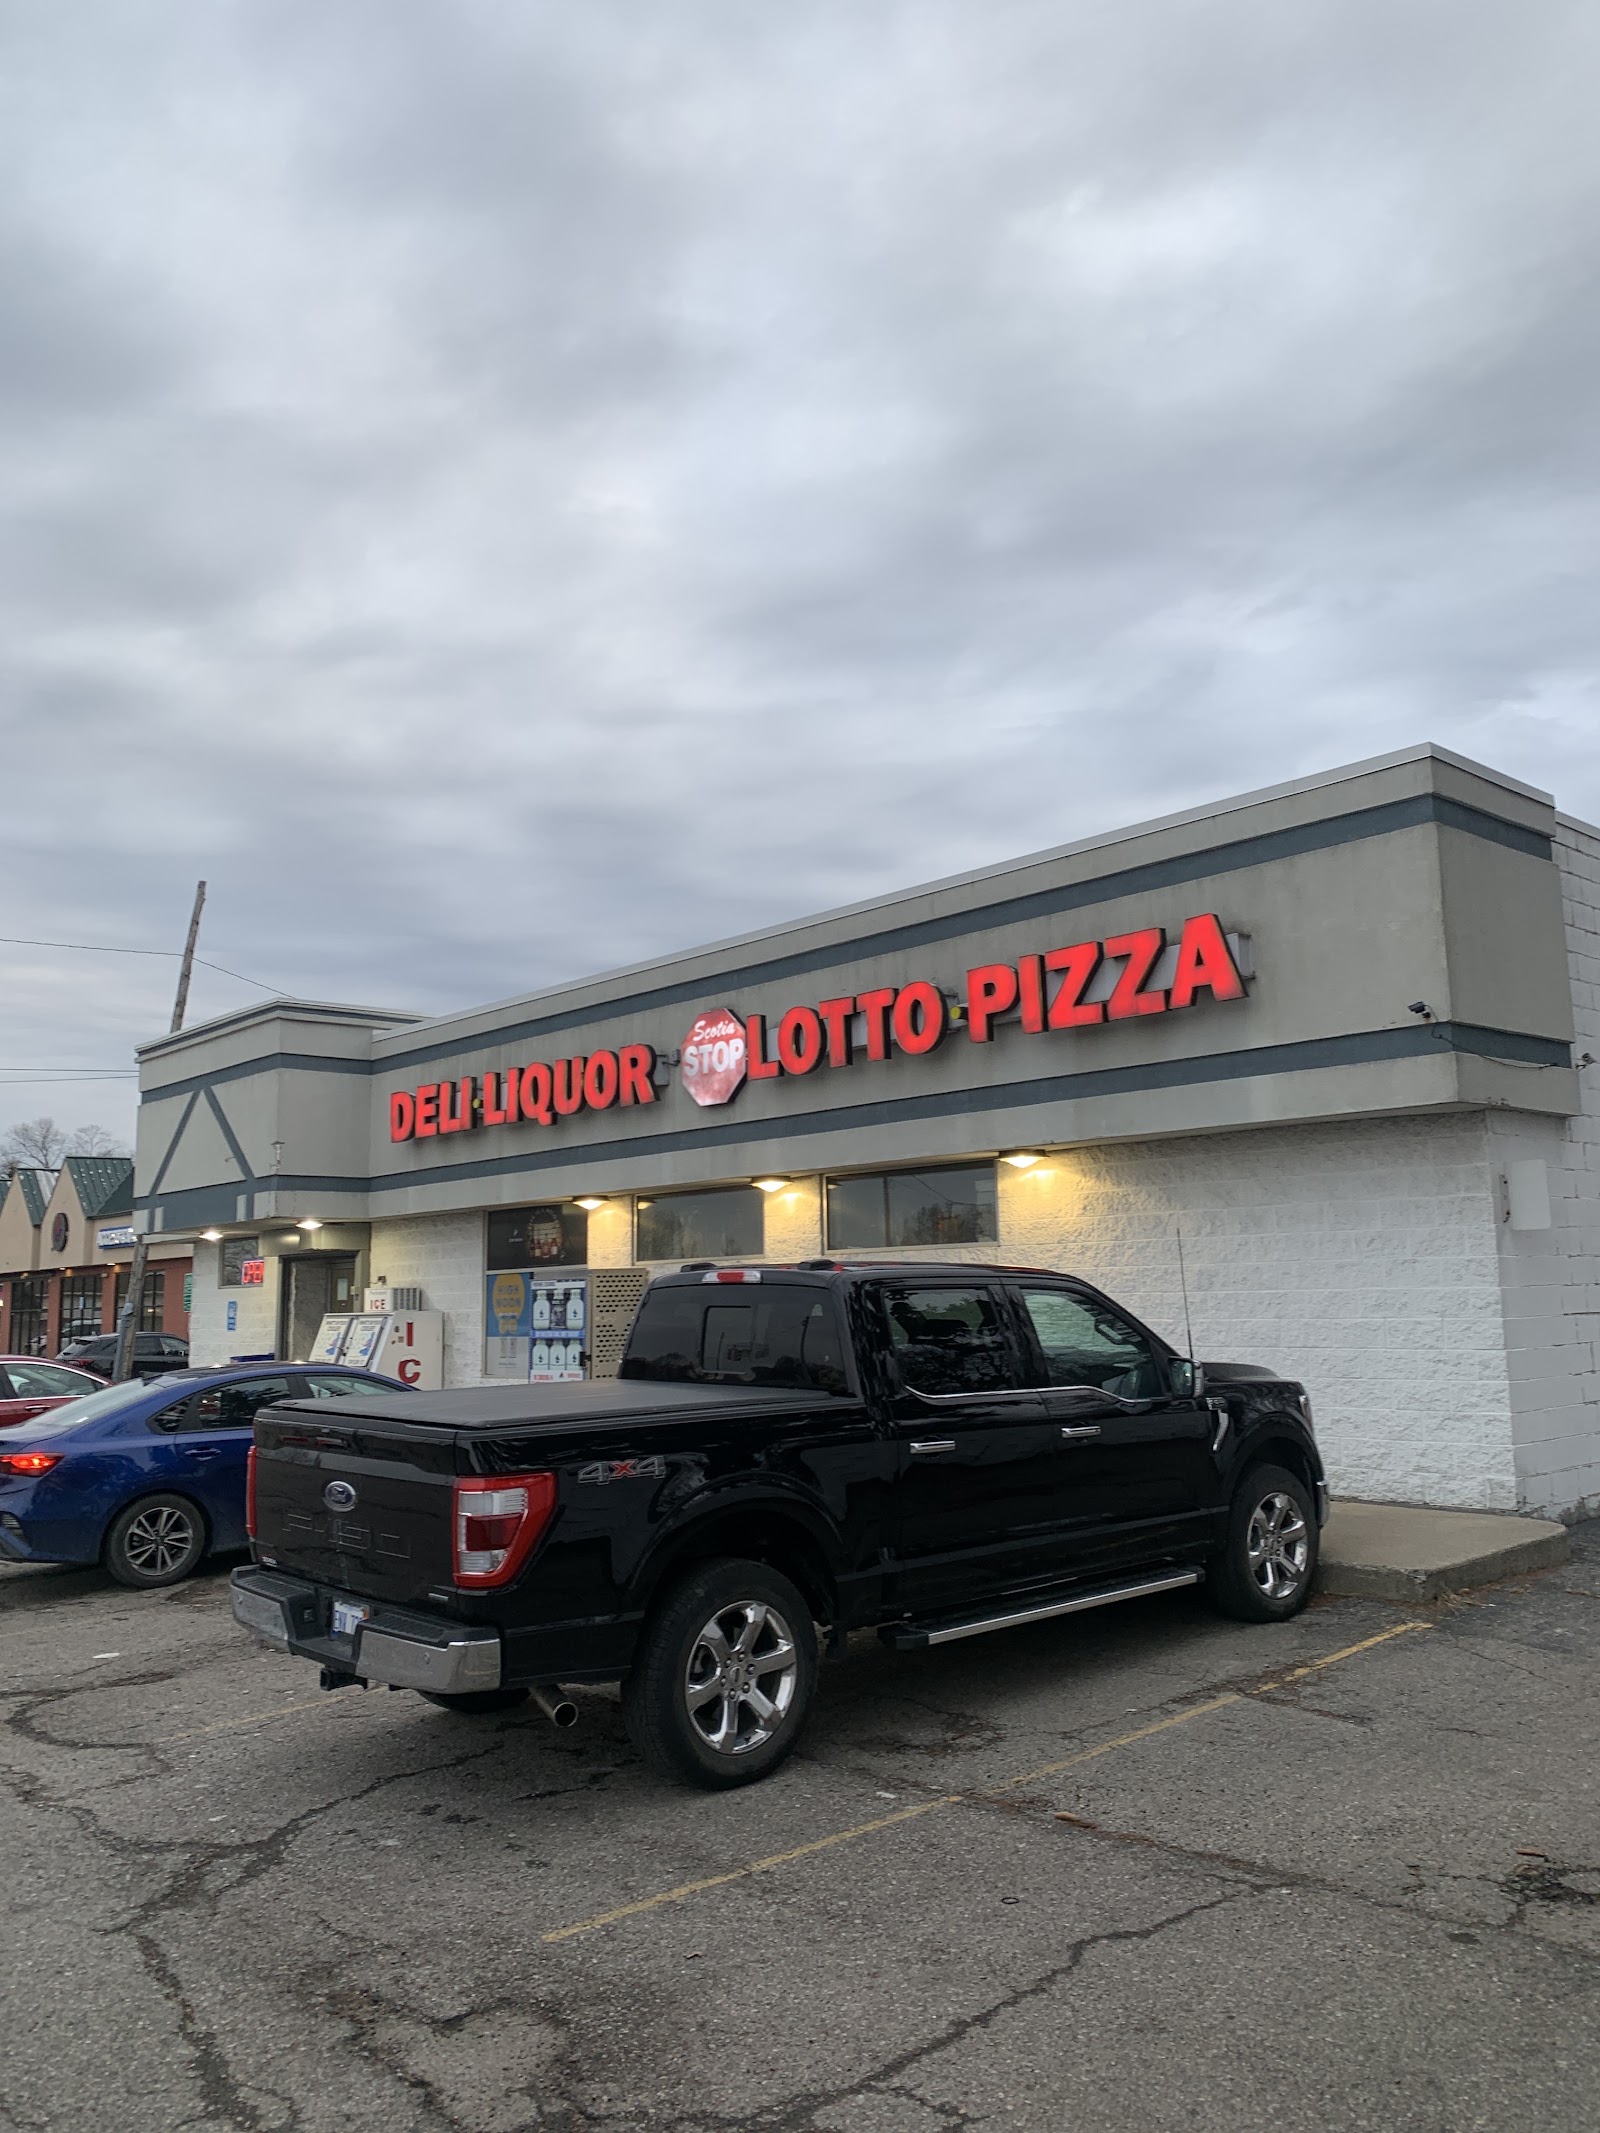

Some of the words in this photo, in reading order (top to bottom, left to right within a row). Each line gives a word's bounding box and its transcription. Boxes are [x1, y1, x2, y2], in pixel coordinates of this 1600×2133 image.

[746, 981, 946, 1081] LOTTO
[967, 912, 1247, 1043] PIZZA
[693, 1020, 736, 1041] Scotia
[684, 1038, 744, 1076] STOP
[390, 1075, 477, 1143] DELI
[483, 1043, 659, 1126] LIQUOR
[370, 1299, 386, 1310] ICE
